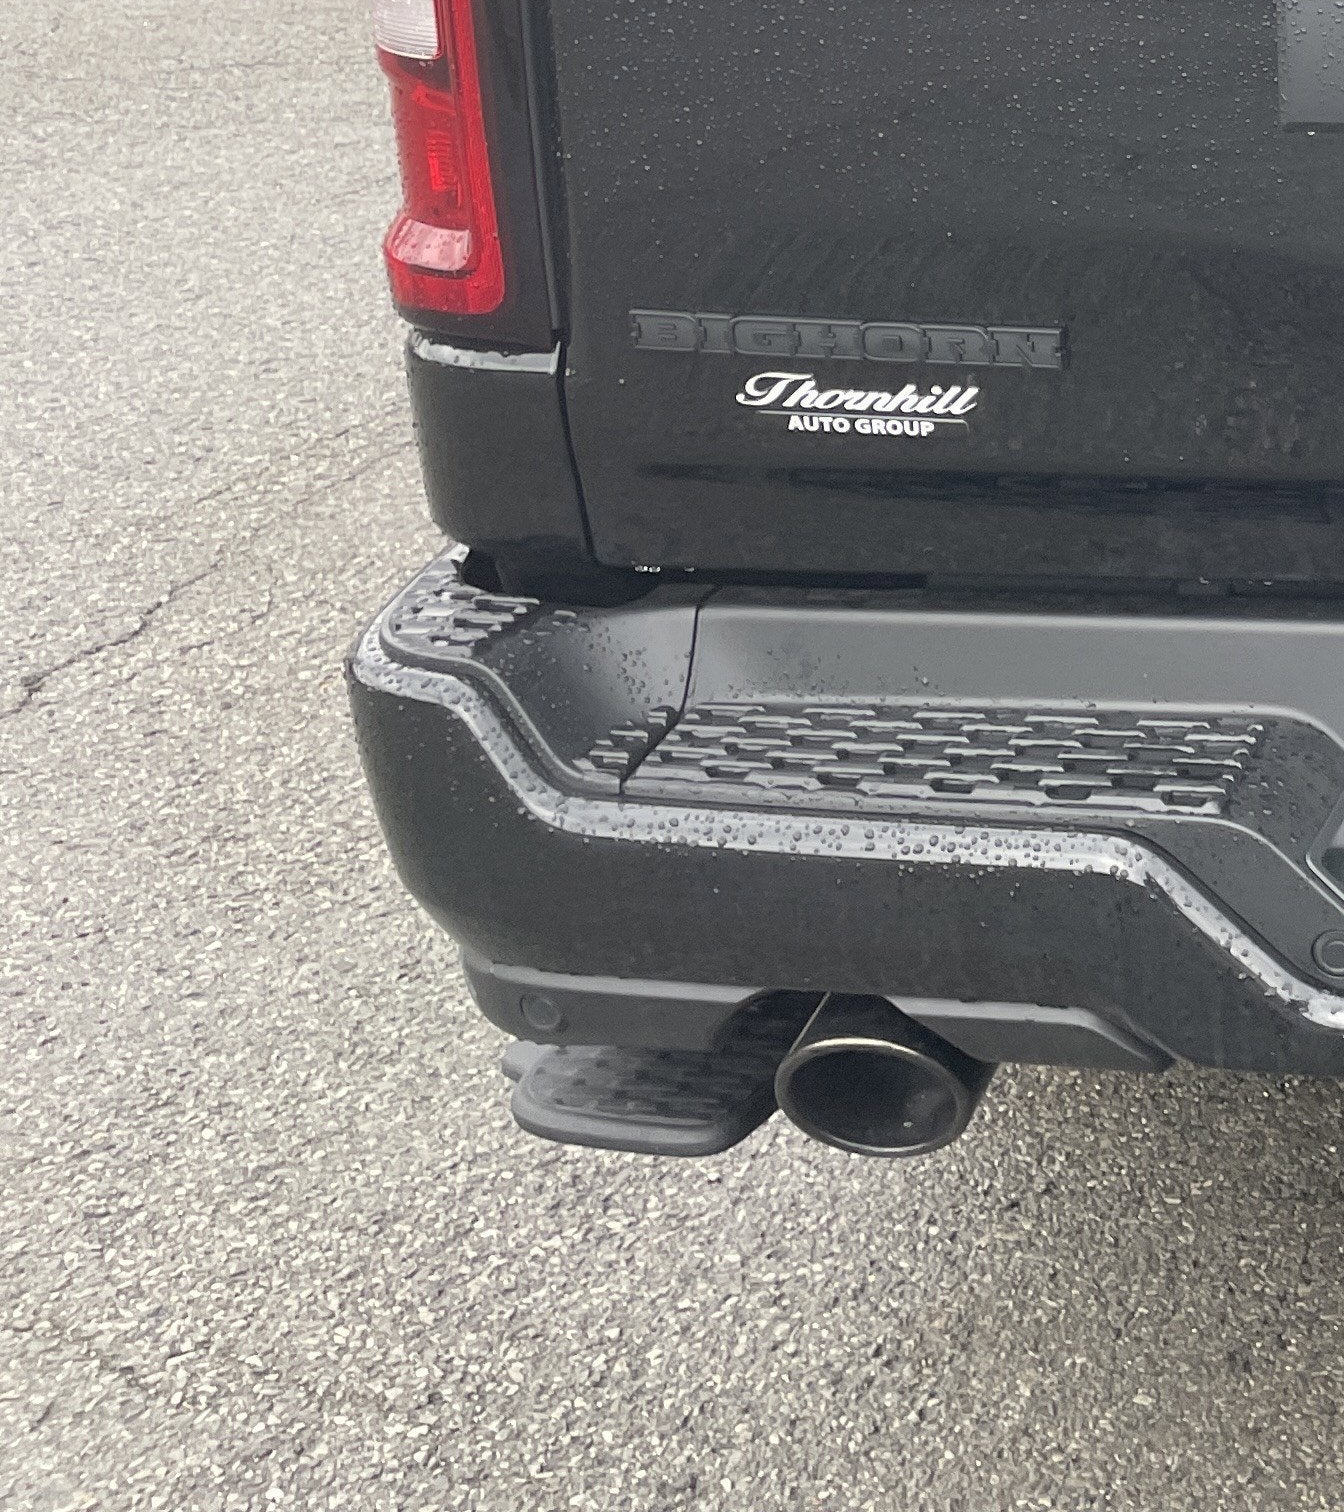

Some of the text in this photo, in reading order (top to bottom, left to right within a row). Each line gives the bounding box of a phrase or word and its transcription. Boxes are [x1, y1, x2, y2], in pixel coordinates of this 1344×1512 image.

[735, 371, 979, 416] Thornhill
[788, 414, 935, 437] AUTO GROUP
